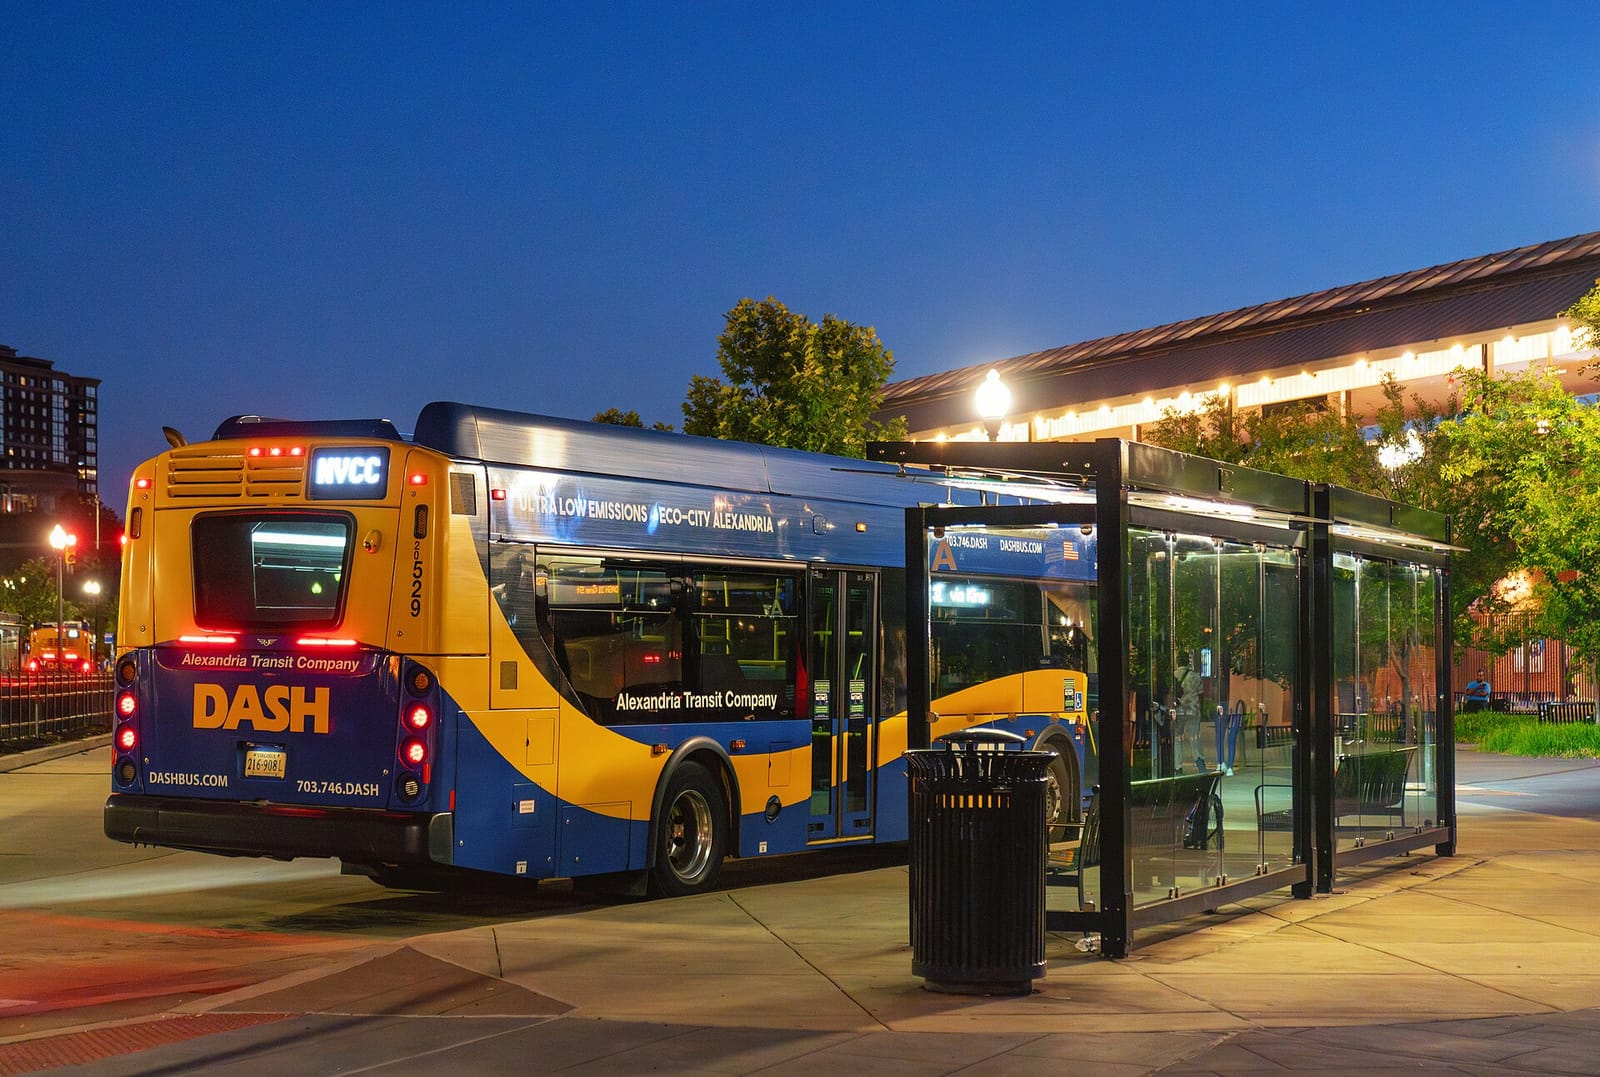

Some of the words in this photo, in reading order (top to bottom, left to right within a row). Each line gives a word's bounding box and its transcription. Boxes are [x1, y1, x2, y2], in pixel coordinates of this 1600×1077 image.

[316, 457, 381, 485] NVCC
[519, 495, 557, 515] ULTRA
[559, 497, 587, 517] LOW
[588, 501, 648, 523] EMISSIONS
[660, 506, 711, 528] ECO-CITY
[713, 511, 774, 533] ALEXANDRIA
[931, 540, 957, 571] A
[1000, 539, 1043, 553] DASHBUS.COM
[181, 653, 247, 667] Alexandria
[251, 655, 294, 669] Transit
[296, 656, 360, 671] Company
[193, 683, 330, 734] DASH
[616, 691, 681, 711] Alexandria
[683, 691, 722, 709] Transit
[725, 690, 777, 710] Company
[149, 771, 229, 788] DASHBUS.COM
[296, 779, 379, 797] 703.746.DASH
